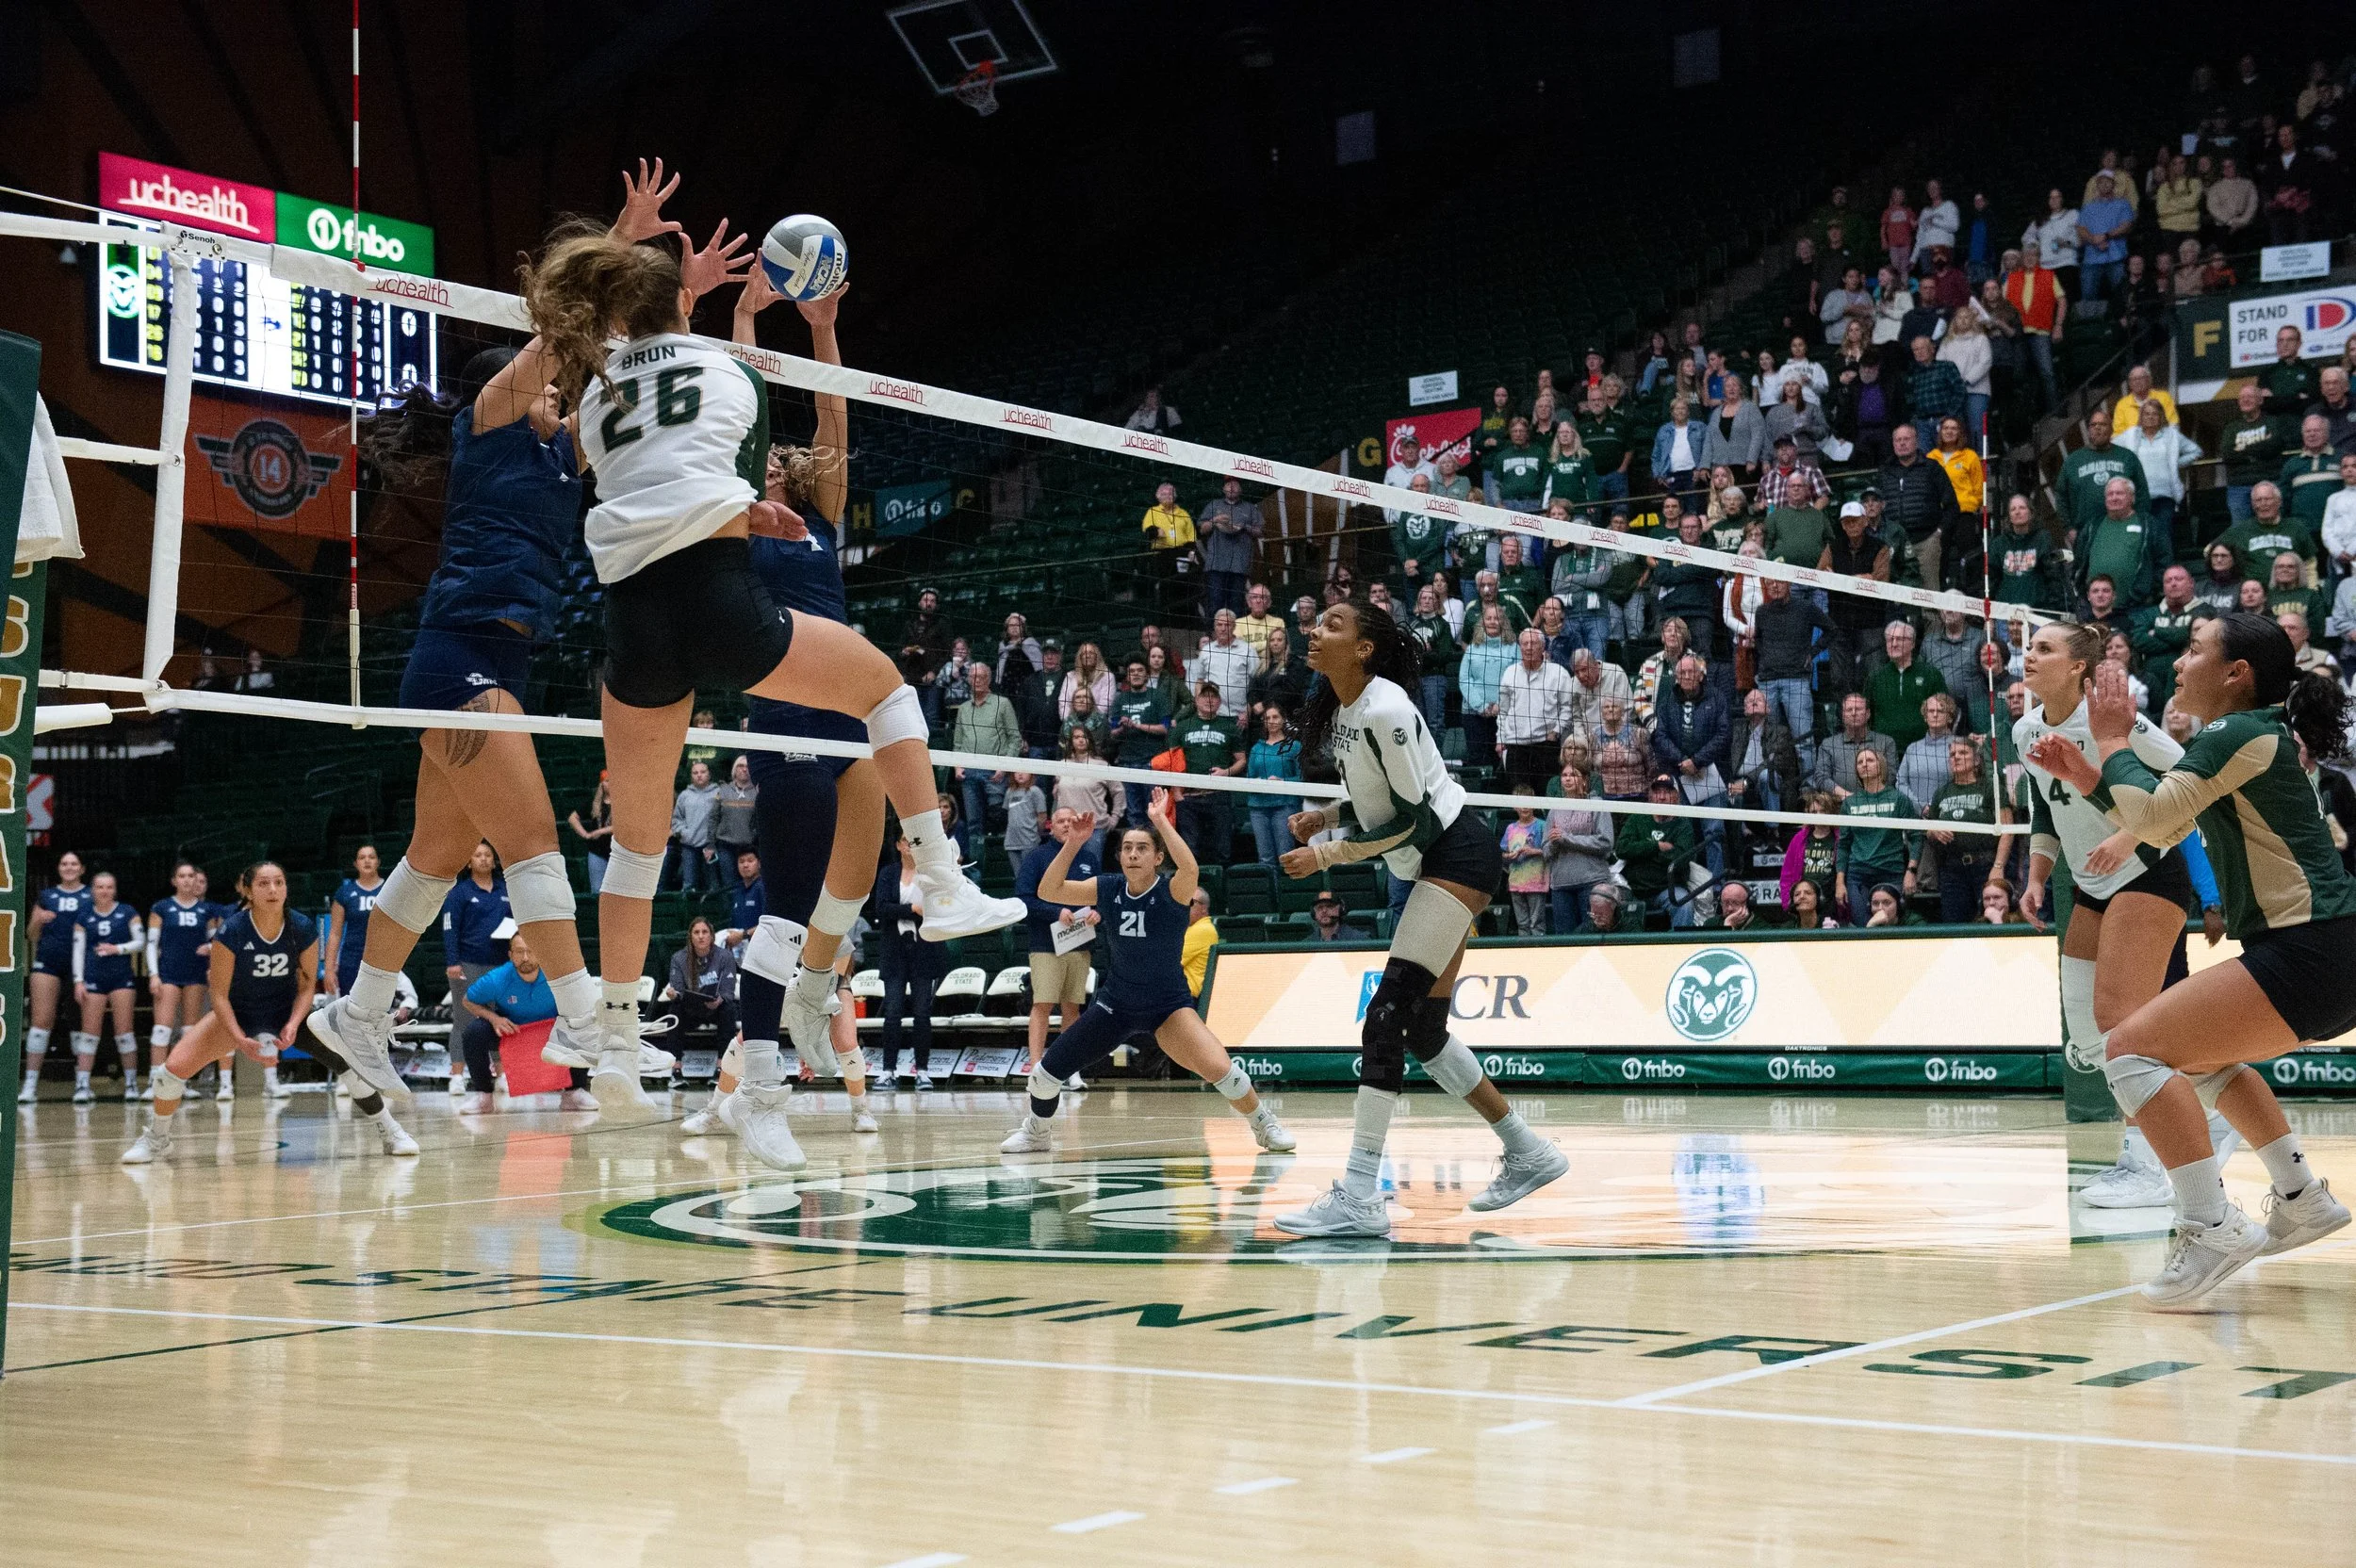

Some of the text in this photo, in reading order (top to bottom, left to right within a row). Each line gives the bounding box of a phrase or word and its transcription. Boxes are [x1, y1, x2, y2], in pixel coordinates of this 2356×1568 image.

[128, 173, 251, 226] uchealth
[188, 233, 216, 244] Senoh
[342, 217, 406, 262] fnbo
[818, 252, 843, 297] molten
[375, 273, 450, 306] uchealth
[2237, 304, 2288, 324] STAND
[2194, 319, 2223, 358] F
[2238, 327, 2268, 344] FOR
[621, 345, 677, 370] BRUN
[723, 345, 782, 375] uchealth
[869, 377, 924, 404] uchealth
[599, 365, 705, 453] 26
[1004, 407, 1053, 430] uchealth
[1123, 432, 1170, 454] uchealth
[1358, 437, 1383, 467] G
[259, 454, 282, 483] 14
[1233, 456, 1275, 478] uchealth
[1333, 478, 1372, 498] uchealth
[852, 502, 873, 531] H
[1425, 498, 1460, 516] uchealth
[1511, 514, 1543, 531] uchealth
[1333, 736, 1351, 753] STATE
[2049, 777, 2072, 807] 4
[58, 896, 79, 912] 18
[359, 895, 378, 911] 10
[1762, 888, 1780, 900] RA
[97, 920, 112, 937] 5
[178, 911, 199, 927] 15
[1056, 919, 1087, 939] molten
[1119, 910, 1147, 938] 21
[253, 953, 289, 978] 32
[1448, 973, 1531, 1021] CR
[1248, 1058, 1283, 1075] fnbo
[1505, 1058, 1545, 1076] fnbo
[1644, 1058, 1686, 1078] fnbo
[1792, 1057, 1836, 1079] fnbo
[1950, 1058, 1998, 1081] fnbo
[2303, 1060, 2356, 1083] fnbo
